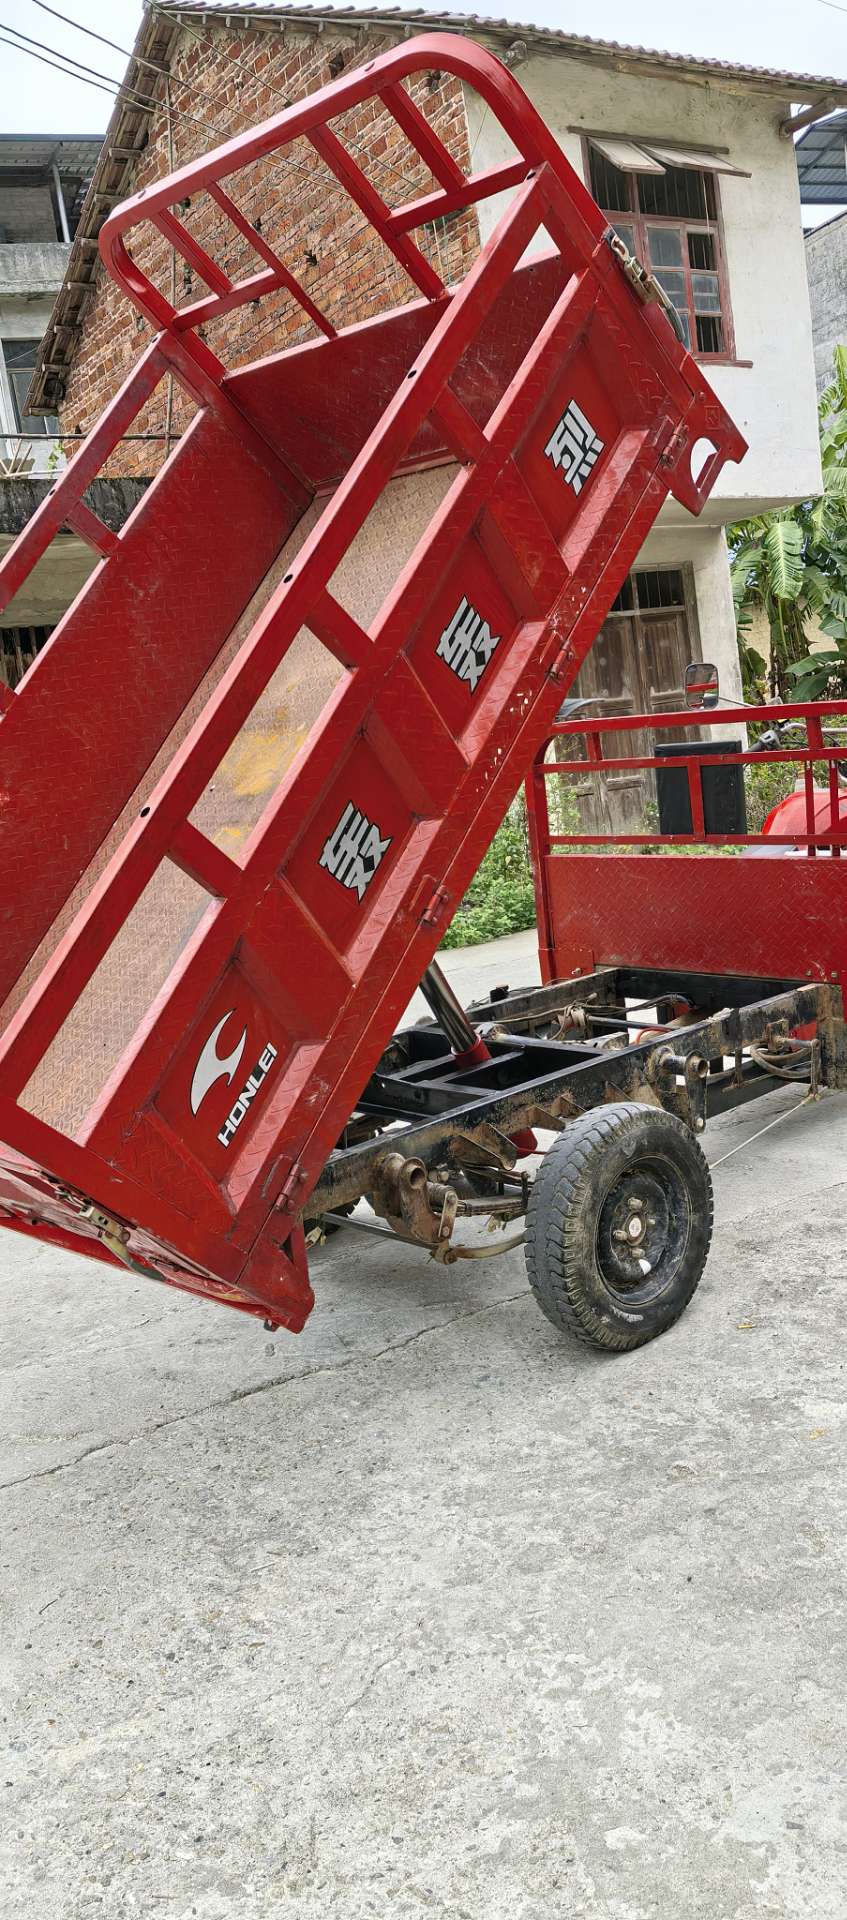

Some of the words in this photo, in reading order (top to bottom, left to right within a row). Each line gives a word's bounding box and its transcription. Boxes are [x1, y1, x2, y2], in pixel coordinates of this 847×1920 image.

[318, 801, 392, 903] 轰
[435, 595, 501, 694] 轰
[544, 398, 605, 496] 烈
[217, 1042, 278, 1148] HONLEI
